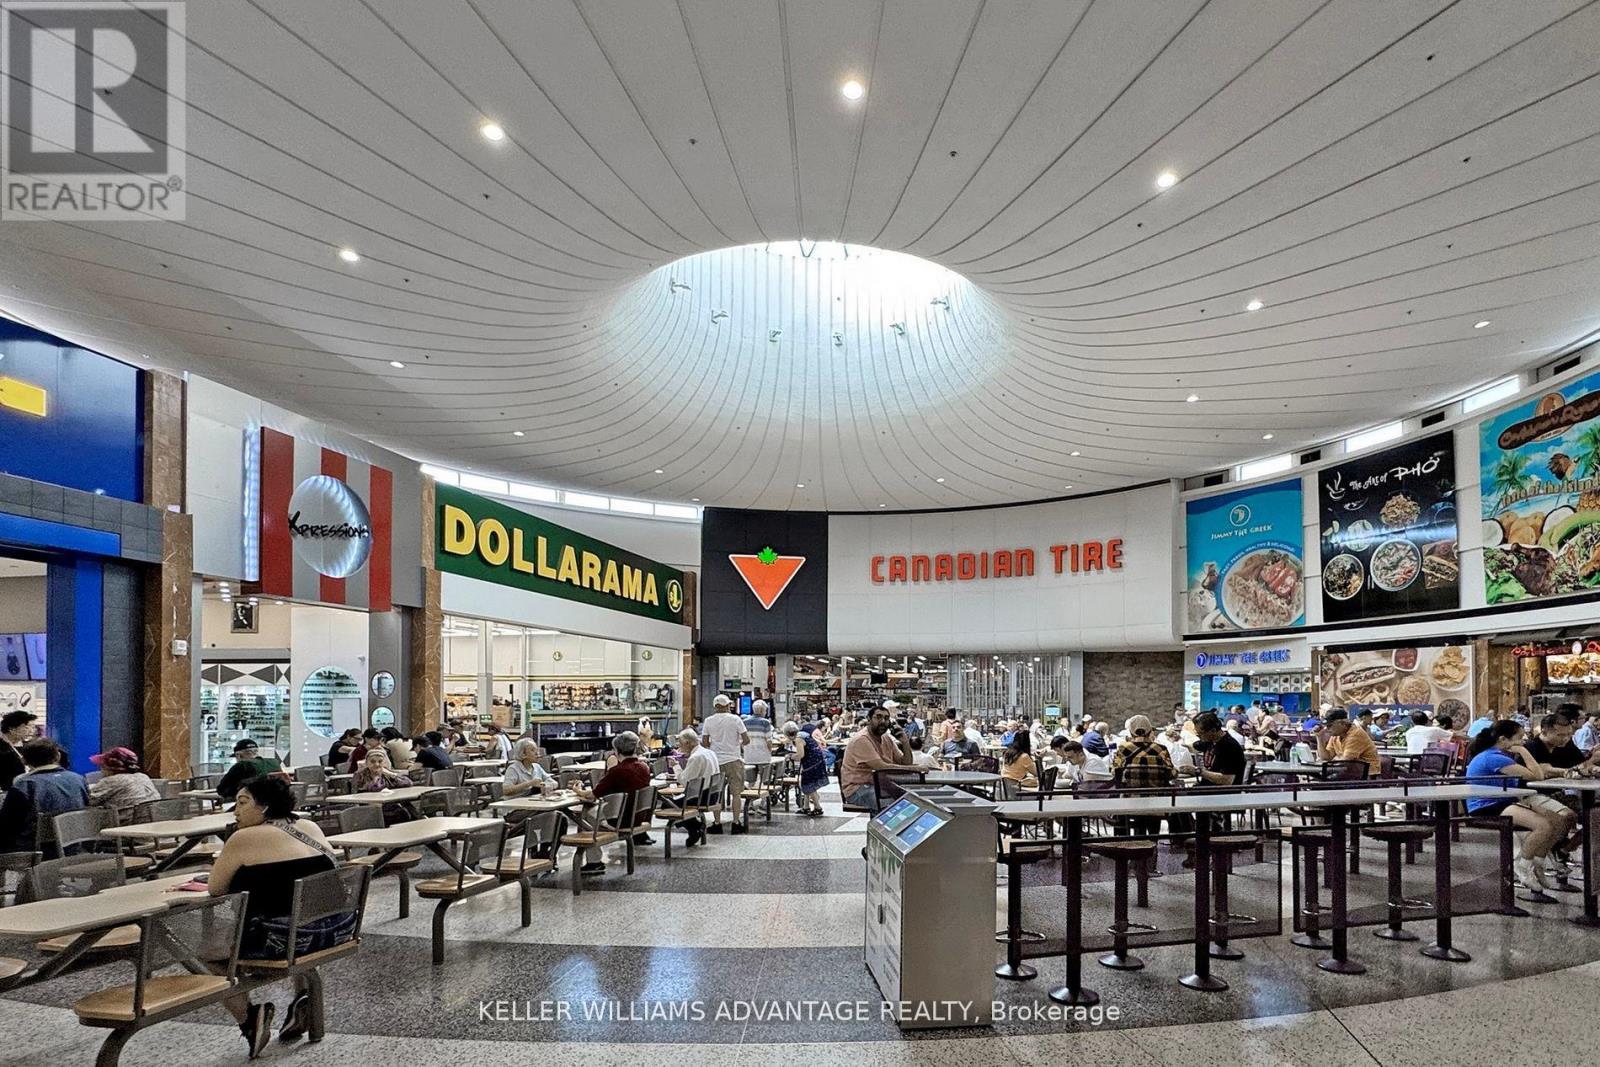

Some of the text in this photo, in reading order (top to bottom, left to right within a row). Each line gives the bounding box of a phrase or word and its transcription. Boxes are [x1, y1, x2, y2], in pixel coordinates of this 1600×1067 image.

[1211, 524, 1273, 540] JIMMY THE GREEK
[442, 503, 660, 607] DOLLARAMA
[870, 539, 1123, 583] CANADIAN TIRE
[1259, 648, 1289, 664] GREEK
